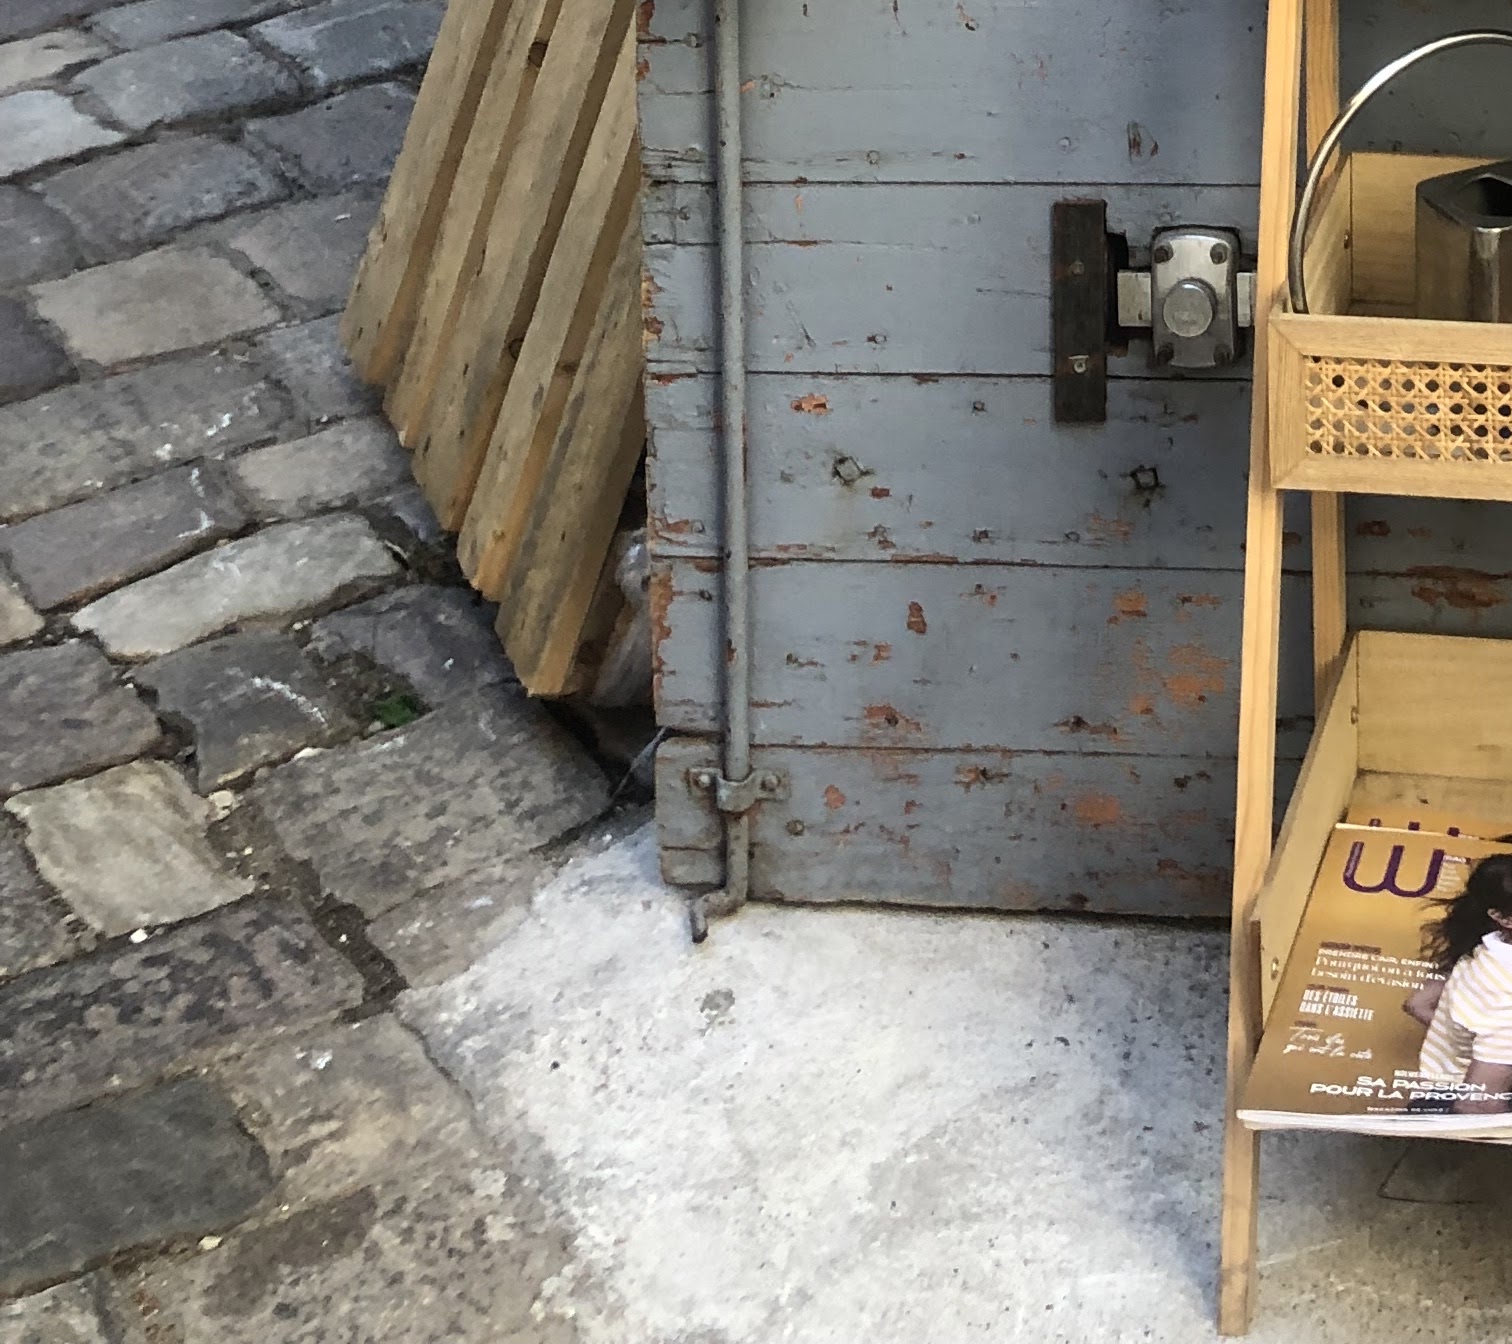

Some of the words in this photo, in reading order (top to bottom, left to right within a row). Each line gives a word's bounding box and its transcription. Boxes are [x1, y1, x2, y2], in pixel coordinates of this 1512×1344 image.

[1310, 1083, 1374, 1098] POUR
[1378, 1089, 1404, 1100] LA
[1357, 1076, 1387, 1089] SA
[1392, 1078, 1486, 1093] PASSION
